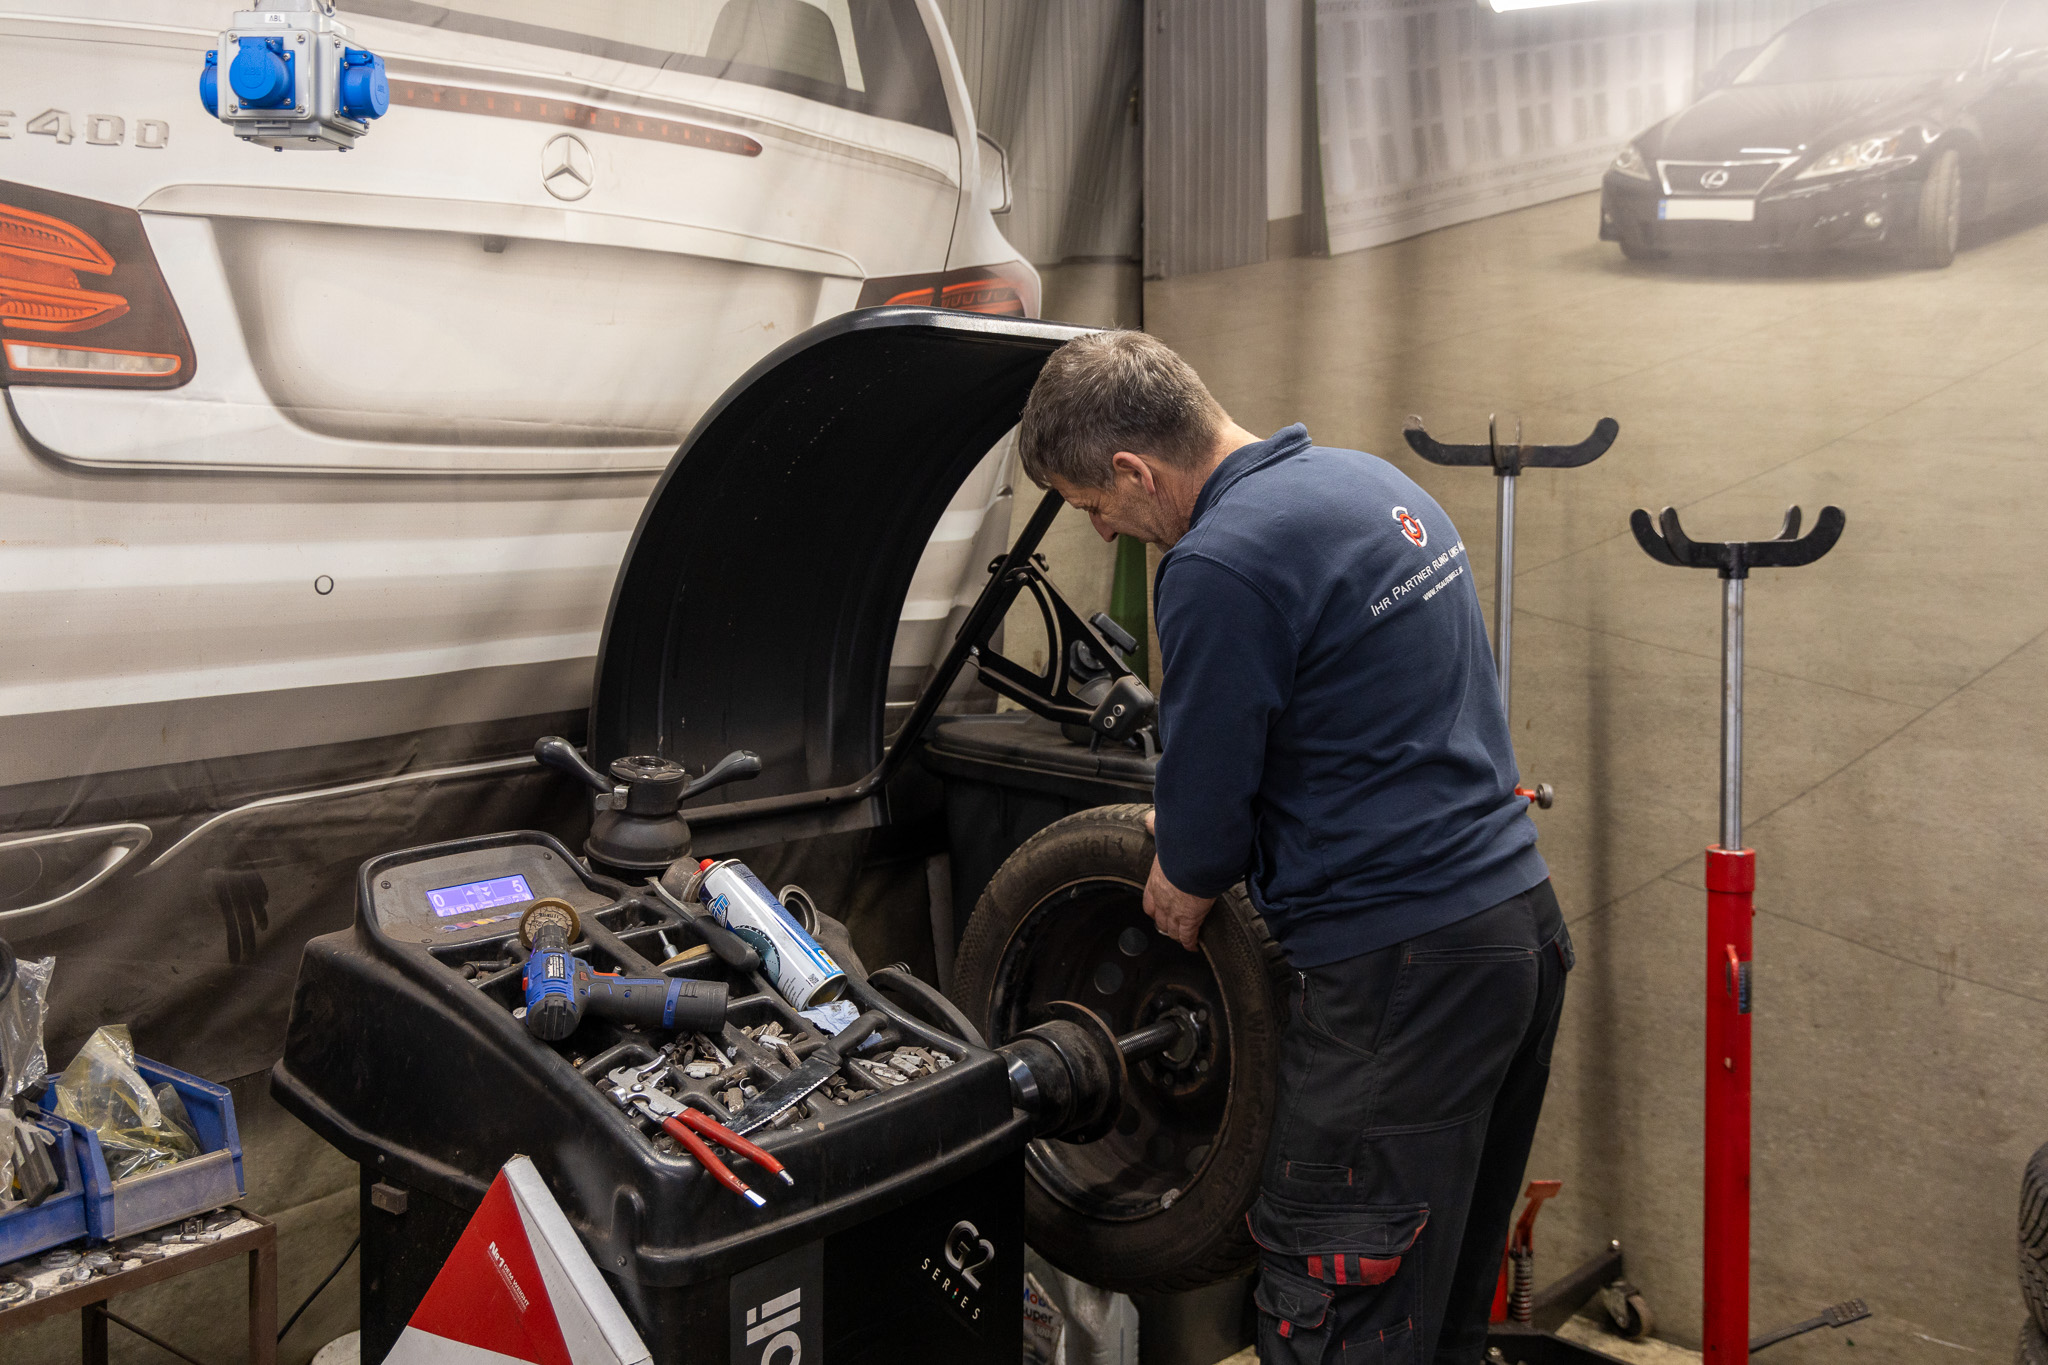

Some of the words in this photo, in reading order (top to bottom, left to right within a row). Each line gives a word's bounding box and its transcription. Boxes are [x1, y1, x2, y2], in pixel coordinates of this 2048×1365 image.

[268, 14, 282, 22] ABL
[1370, 597, 1392, 617] IHR
[1391, 565, 1434, 600] PARTNER
[512, 879, 524, 893] 5
[944, 1220, 995, 1290] G2
[921, 1257, 981, 1320] SERIES
[1024, 1306, 1053, 1325] uper
